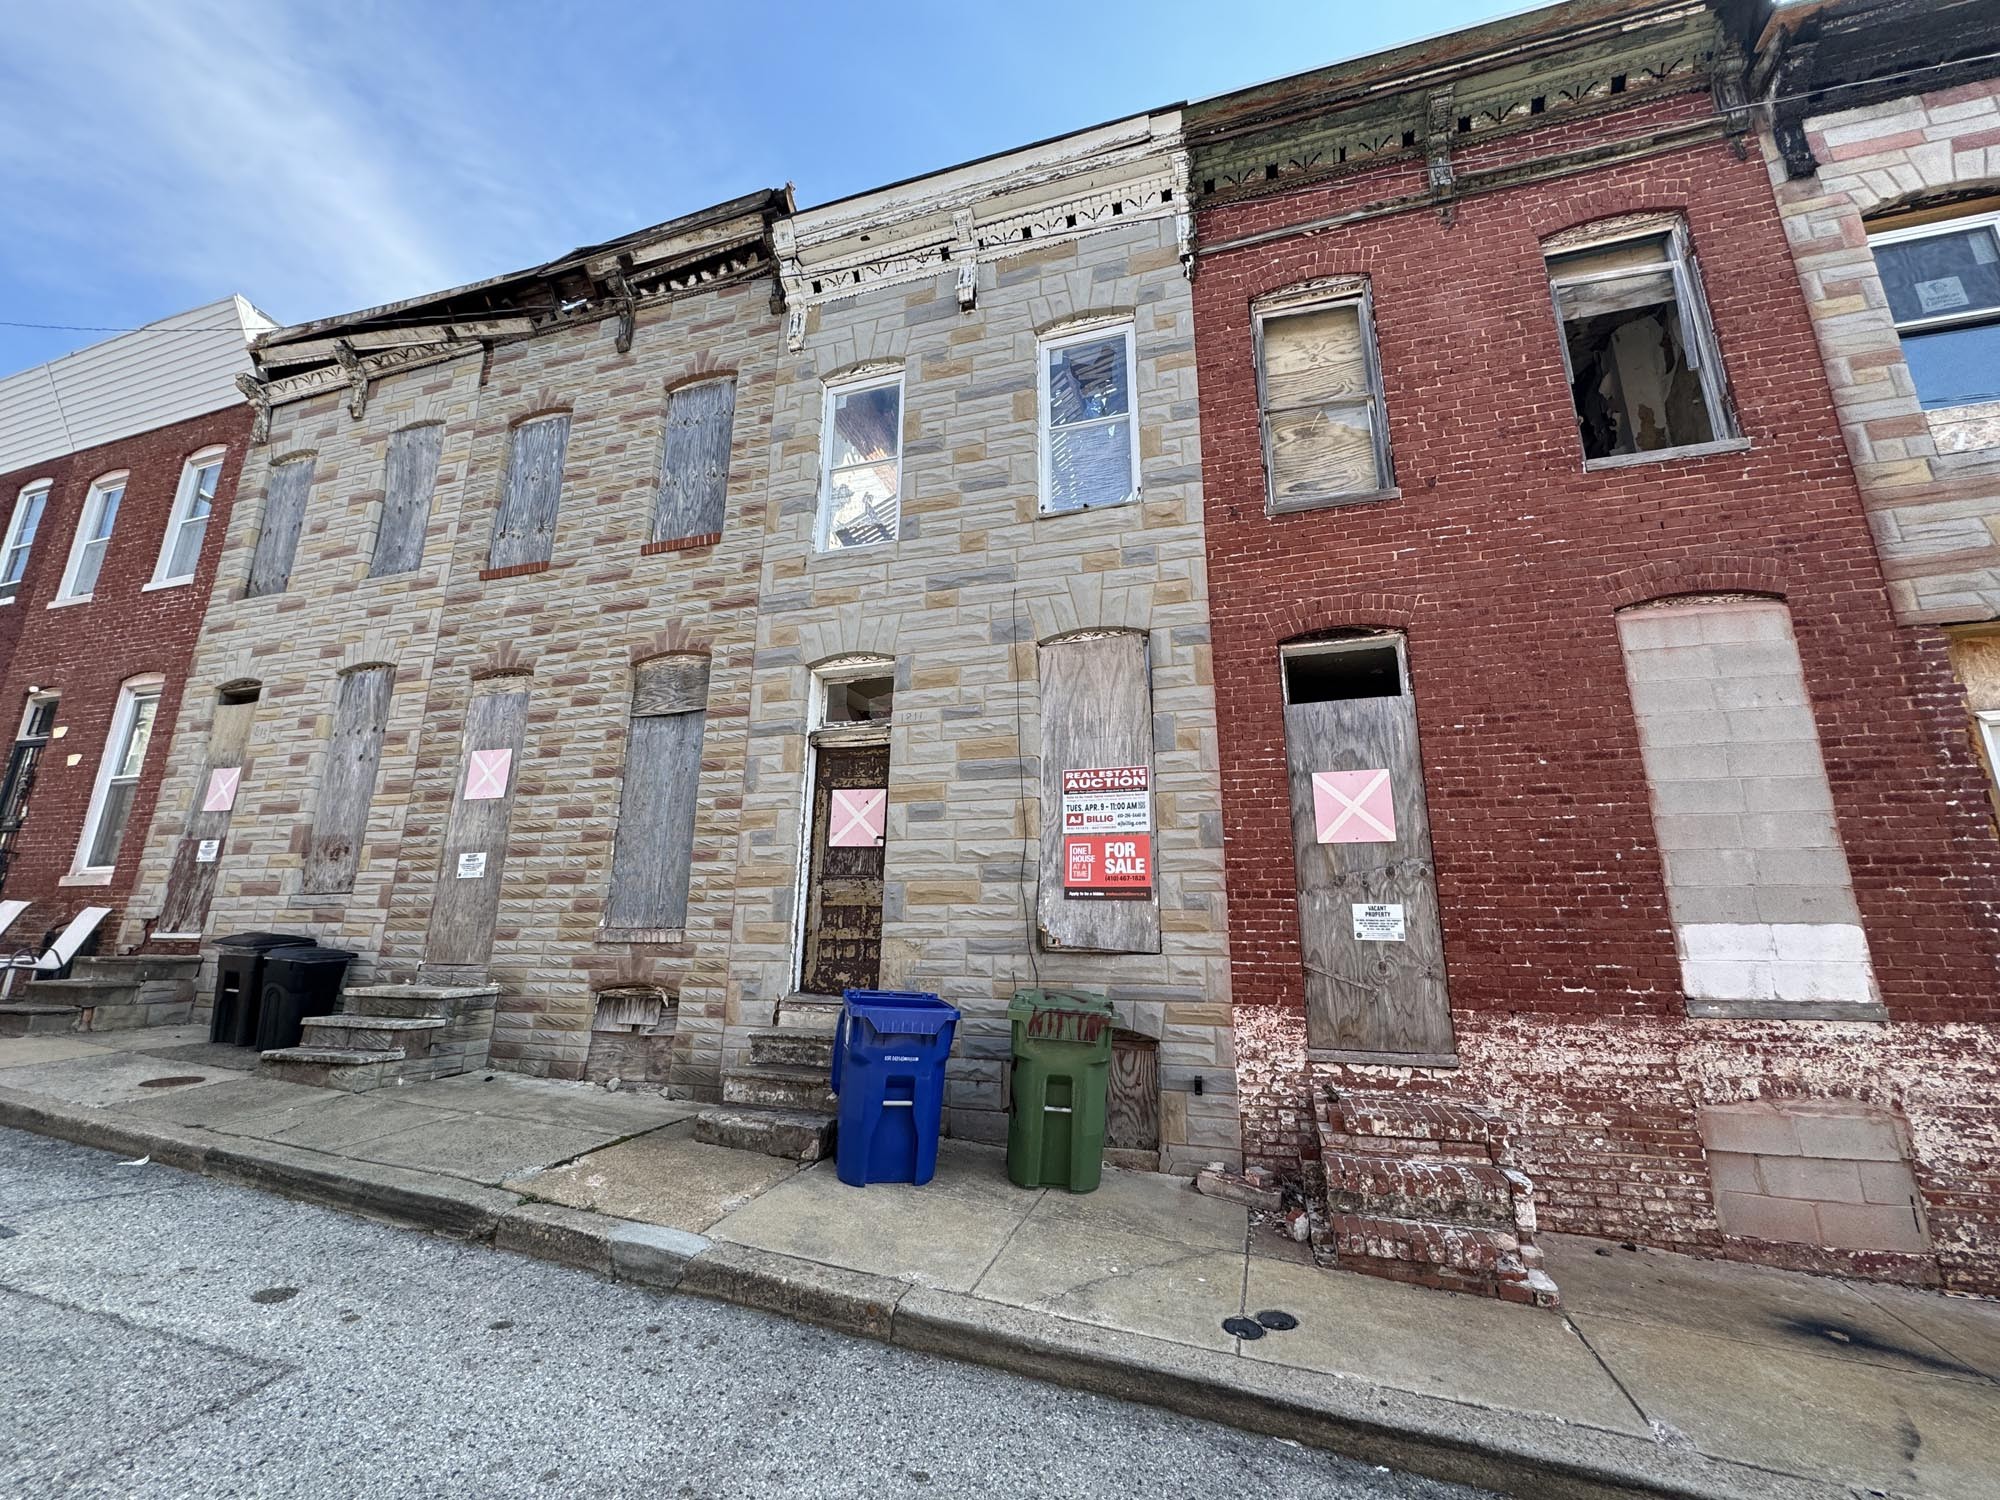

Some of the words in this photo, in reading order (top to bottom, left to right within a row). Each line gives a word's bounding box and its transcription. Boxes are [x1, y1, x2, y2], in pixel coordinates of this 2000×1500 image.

[1066, 775, 1146, 789] AUCTION
[1066, 803, 1084, 812] TUES.
[1085, 803, 1100, 812] APR.
[1110, 802, 1126, 811] 11:00
[1126, 801, 1138, 810] AM
[1069, 815, 1082, 824] AJ
[1086, 814, 1114, 823] BILLIG
[1072, 846, 1088, 855] ONE
[1104, 841, 1136, 858] FOR
[1072, 854, 1096, 863] HOUSE
[1104, 858, 1146, 875] SALE
[1072, 870, 1088, 878] TIME
